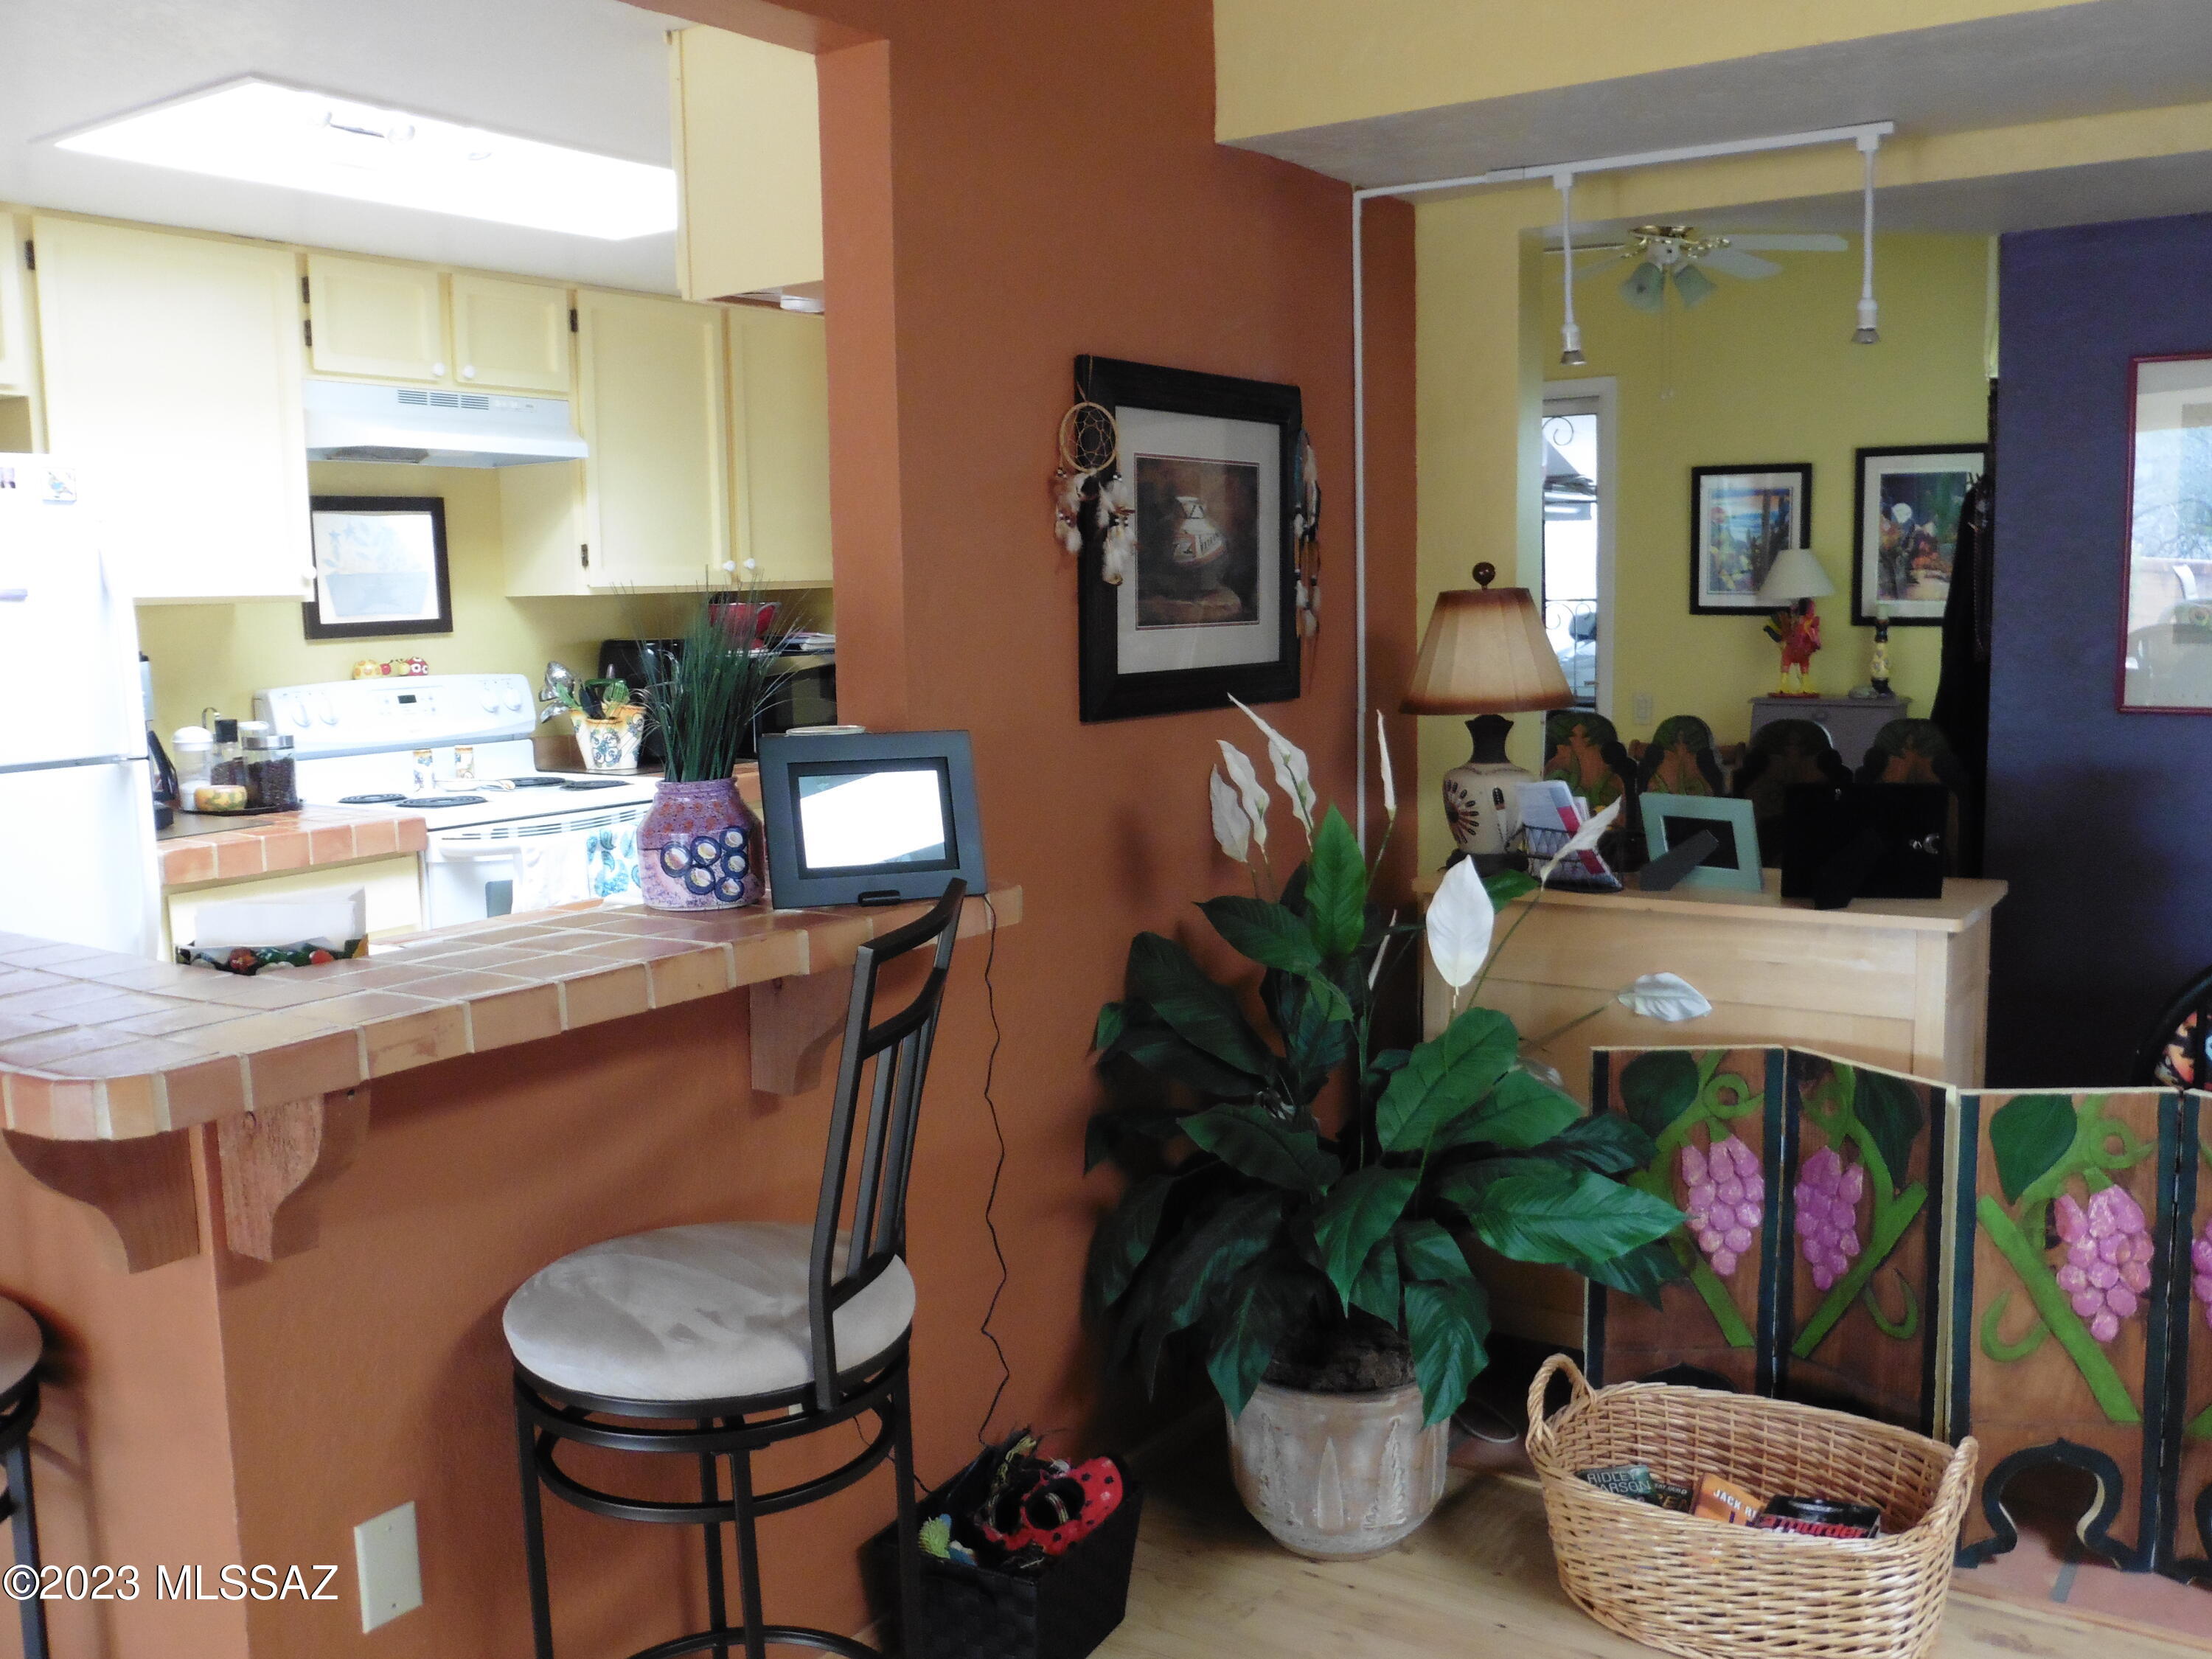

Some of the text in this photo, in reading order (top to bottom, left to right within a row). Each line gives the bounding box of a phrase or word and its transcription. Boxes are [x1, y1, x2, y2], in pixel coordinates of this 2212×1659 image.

[1587, 1472, 1636, 1484] RIDLEY
[1600, 1480, 1652, 1494] ARSON
[1714, 1489, 1742, 1510] JACK
